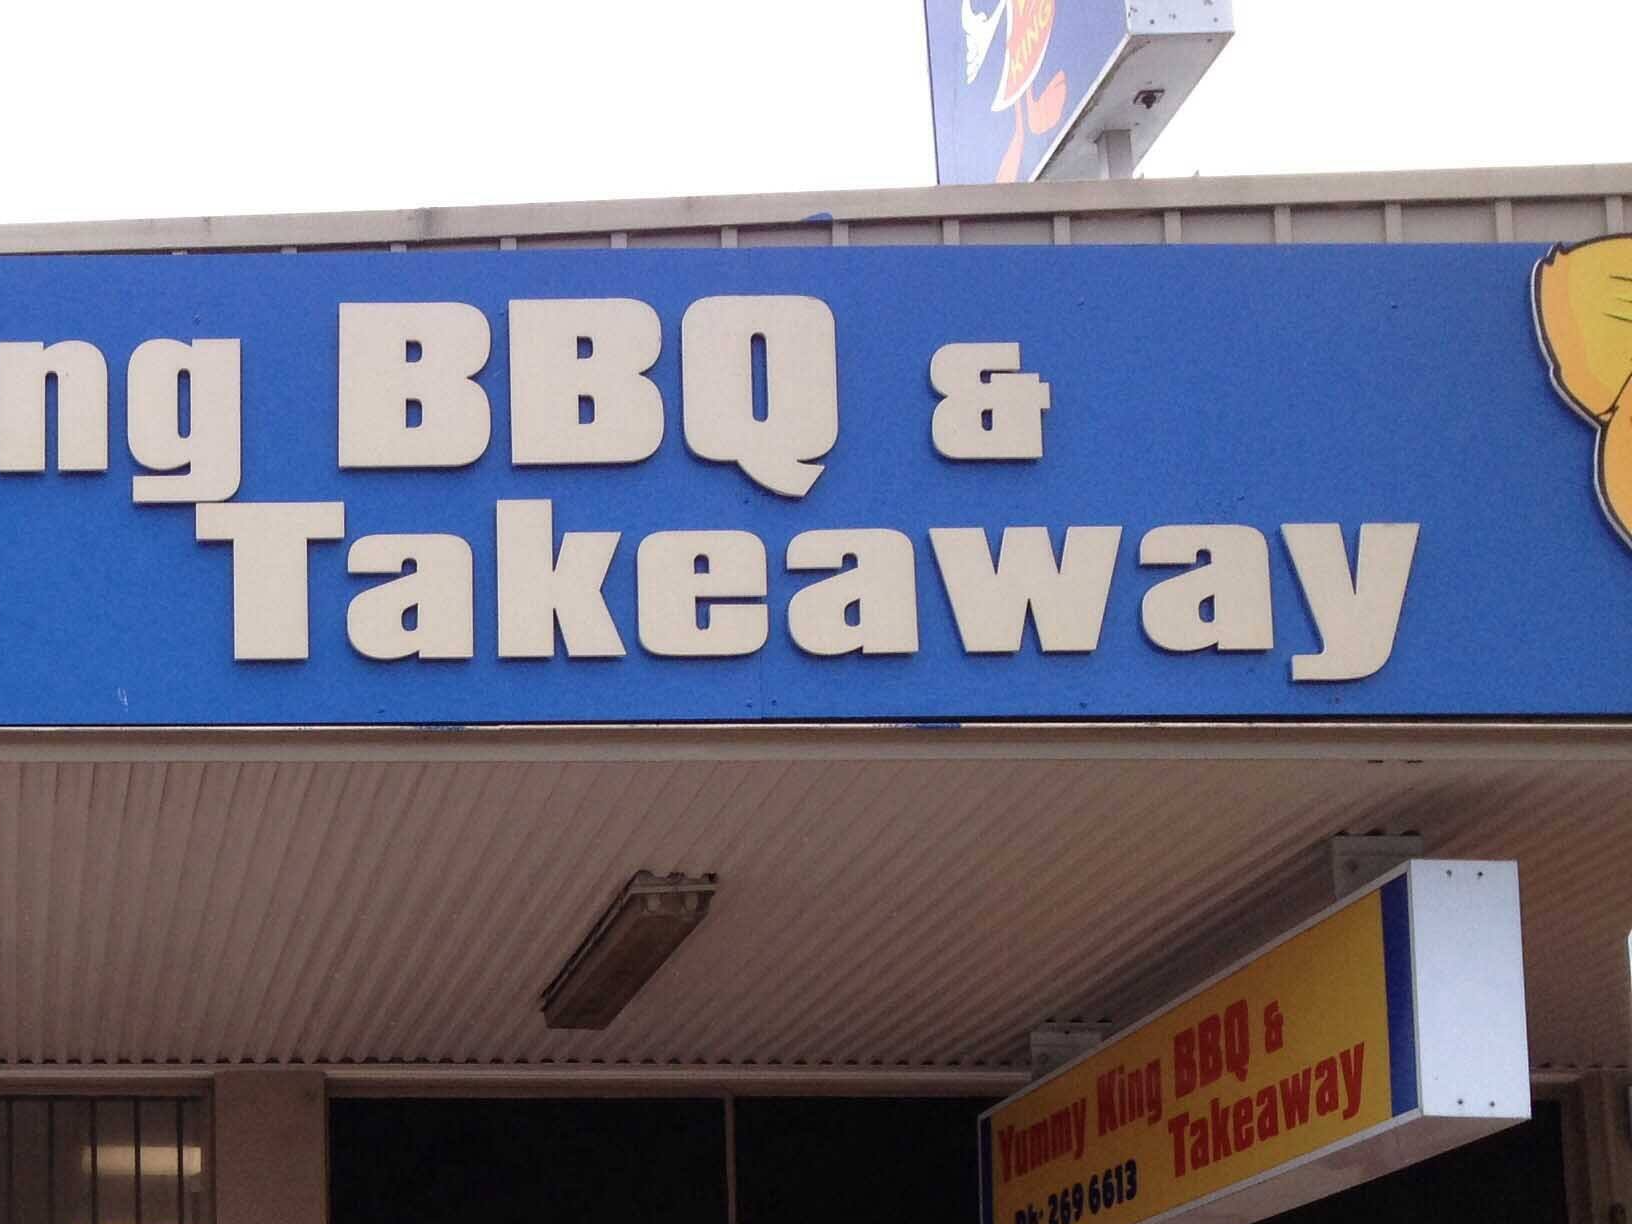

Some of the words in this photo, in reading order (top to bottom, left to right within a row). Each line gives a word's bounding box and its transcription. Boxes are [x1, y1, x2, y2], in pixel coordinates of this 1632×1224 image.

[338, 294, 839, 499] BBQ
[929, 342, 1050, 462] &
[195, 499, 1420, 682] Takeaway
[998, 1098, 1087, 1183] Yummy
[1096, 1058, 1164, 1136] King
[1173, 999, 1251, 1098] BBQ
[1263, 1000, 1284, 1054] &
[1168, 1041, 1366, 1178] Takeaway
[1088, 1159, 1137, 1214] 6613
